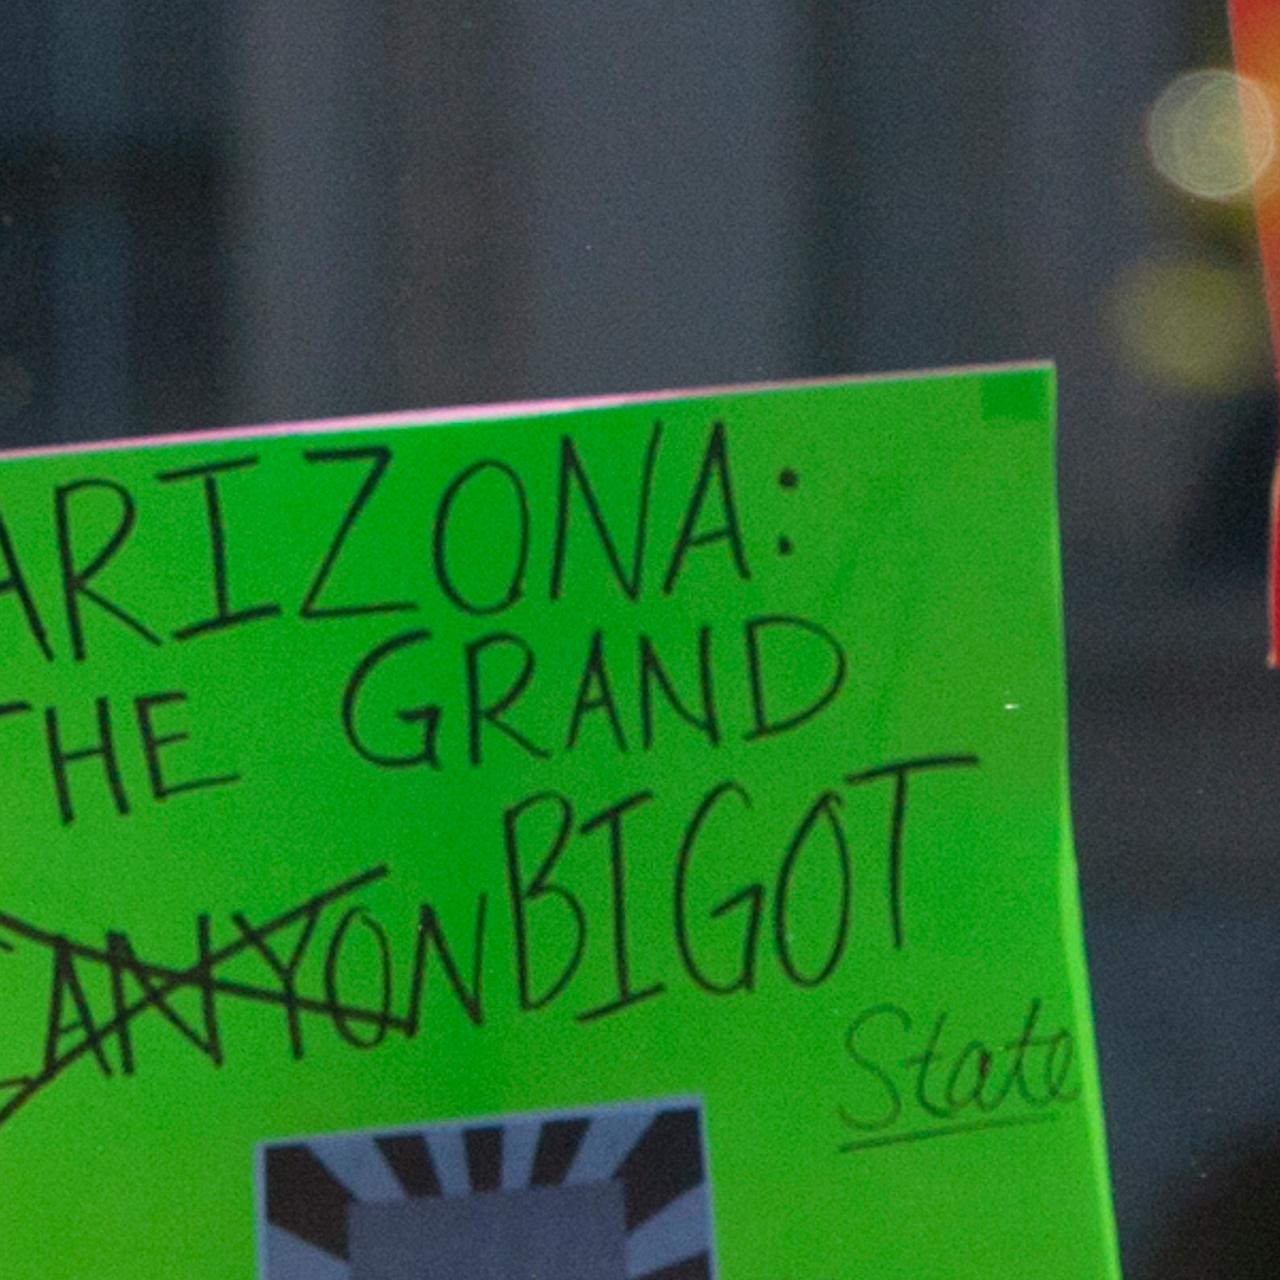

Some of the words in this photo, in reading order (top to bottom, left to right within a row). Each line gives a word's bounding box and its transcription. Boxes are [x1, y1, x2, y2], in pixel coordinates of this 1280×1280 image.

[342, 615, 846, 770] GRAND
[503, 755, 980, 1022] BIGOT
[840, 997, 1081, 1132] State
